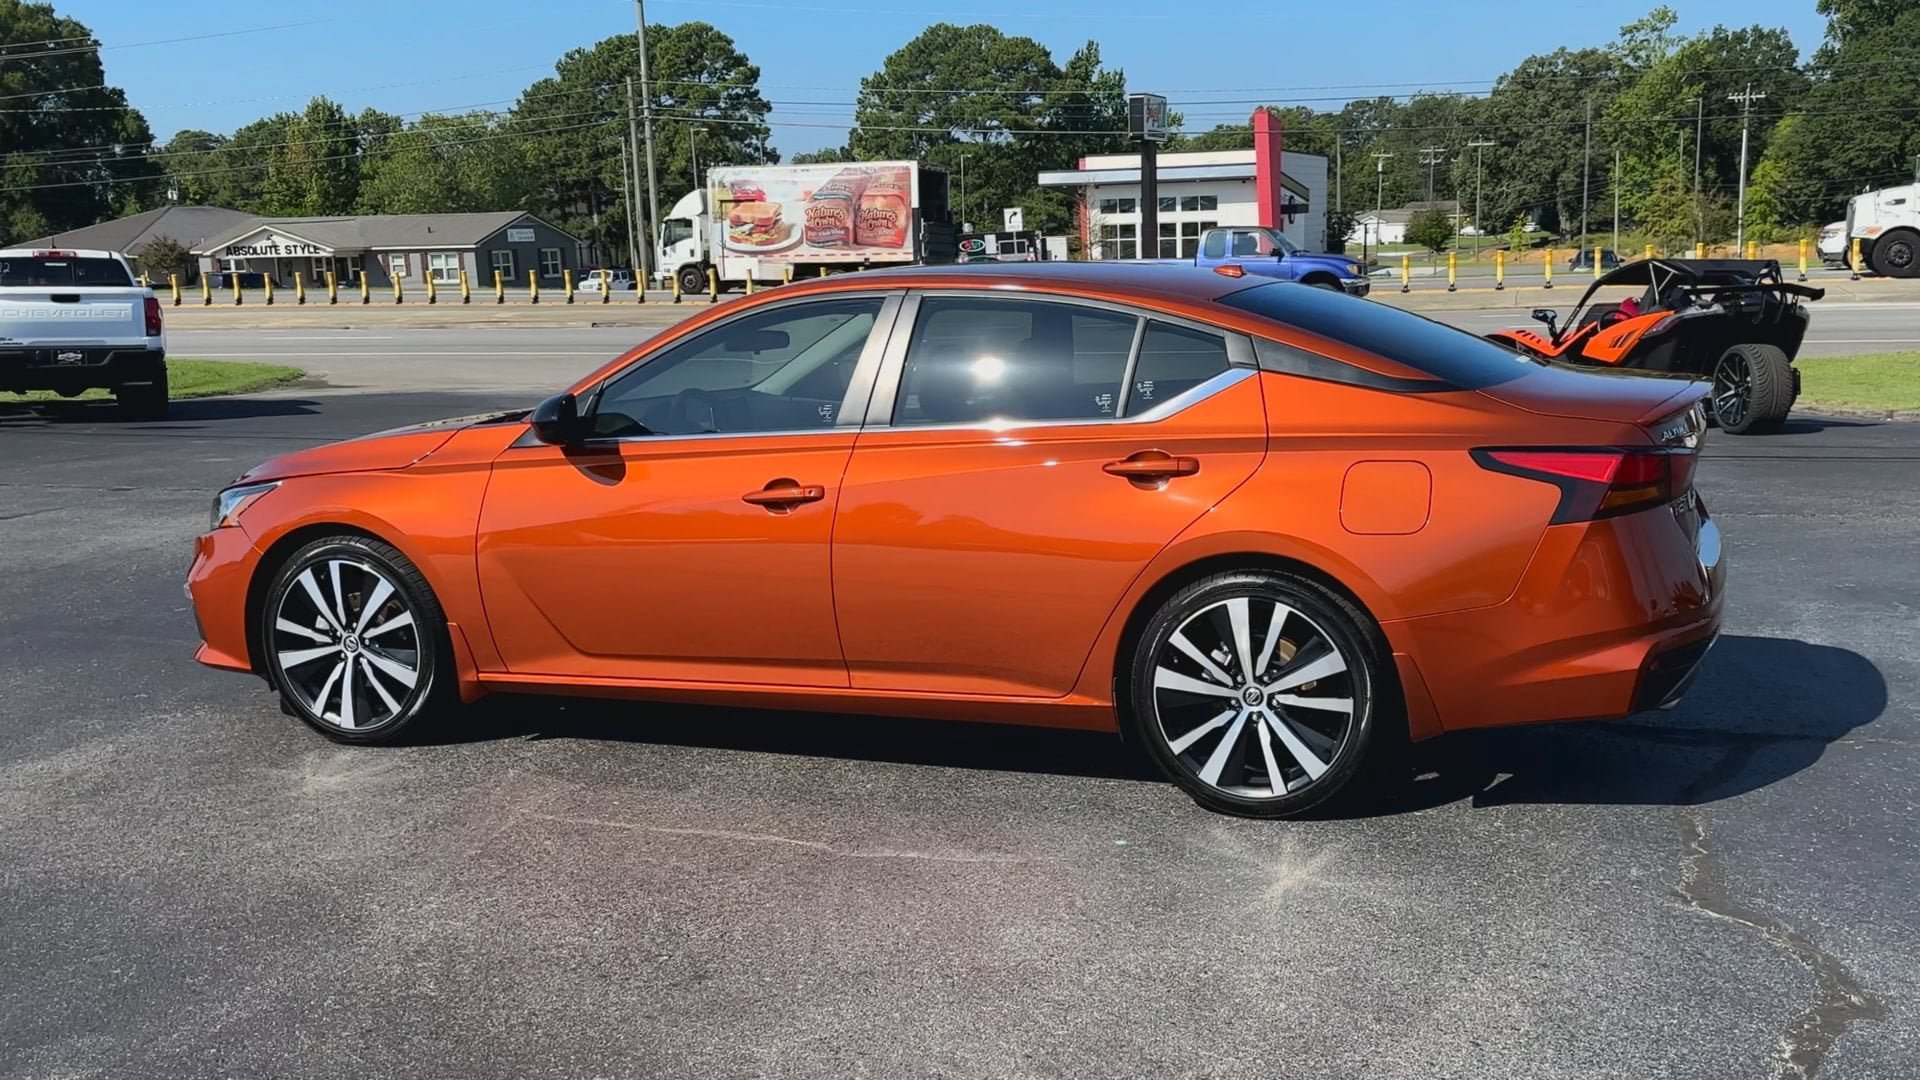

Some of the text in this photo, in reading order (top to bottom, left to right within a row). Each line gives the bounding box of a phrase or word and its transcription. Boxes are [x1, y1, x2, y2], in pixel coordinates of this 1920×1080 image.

[225, 244, 320, 256] ABSOLUTE STYLE
[2, 308, 129, 319] CHEVROLET
